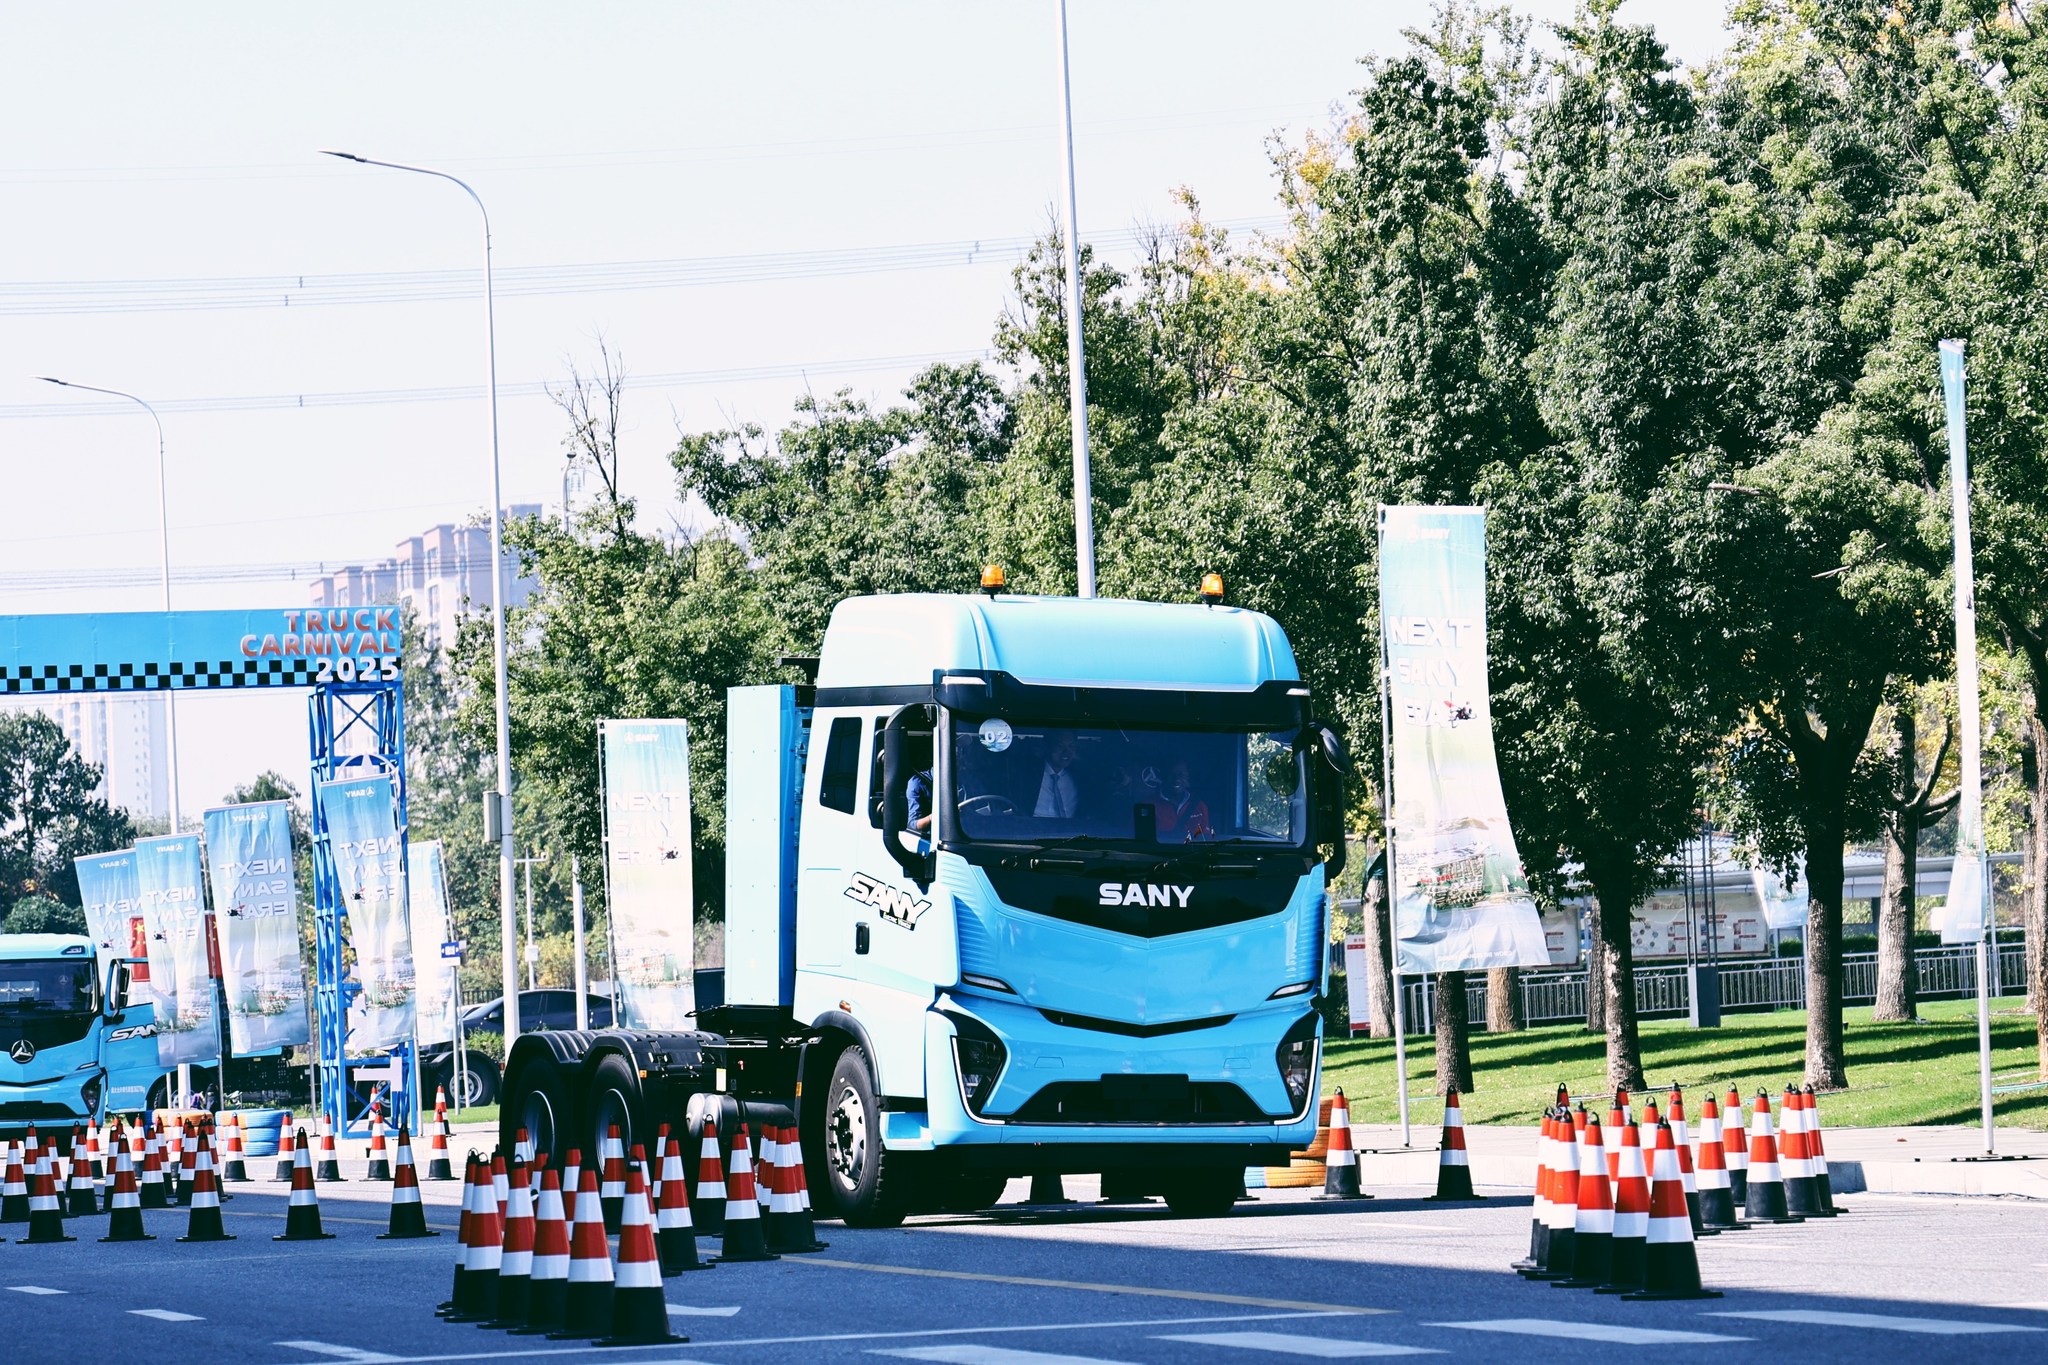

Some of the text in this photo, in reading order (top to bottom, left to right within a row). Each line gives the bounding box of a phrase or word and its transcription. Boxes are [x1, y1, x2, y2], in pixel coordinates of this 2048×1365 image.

[283, 608, 395, 632] TRUCK
[1389, 615, 1471, 648] NEXT
[240, 632, 397, 657] CARNIVAL
[315, 656, 399, 682] 2025
[1397, 657, 1471, 687] SANY
[985, 731, 1007, 744] 02
[611, 792, 680, 812] NEXT
[844, 872, 932, 924] SANY
[1099, 882, 1195, 907] SANY
[107, 1024, 157, 1042] SAN
